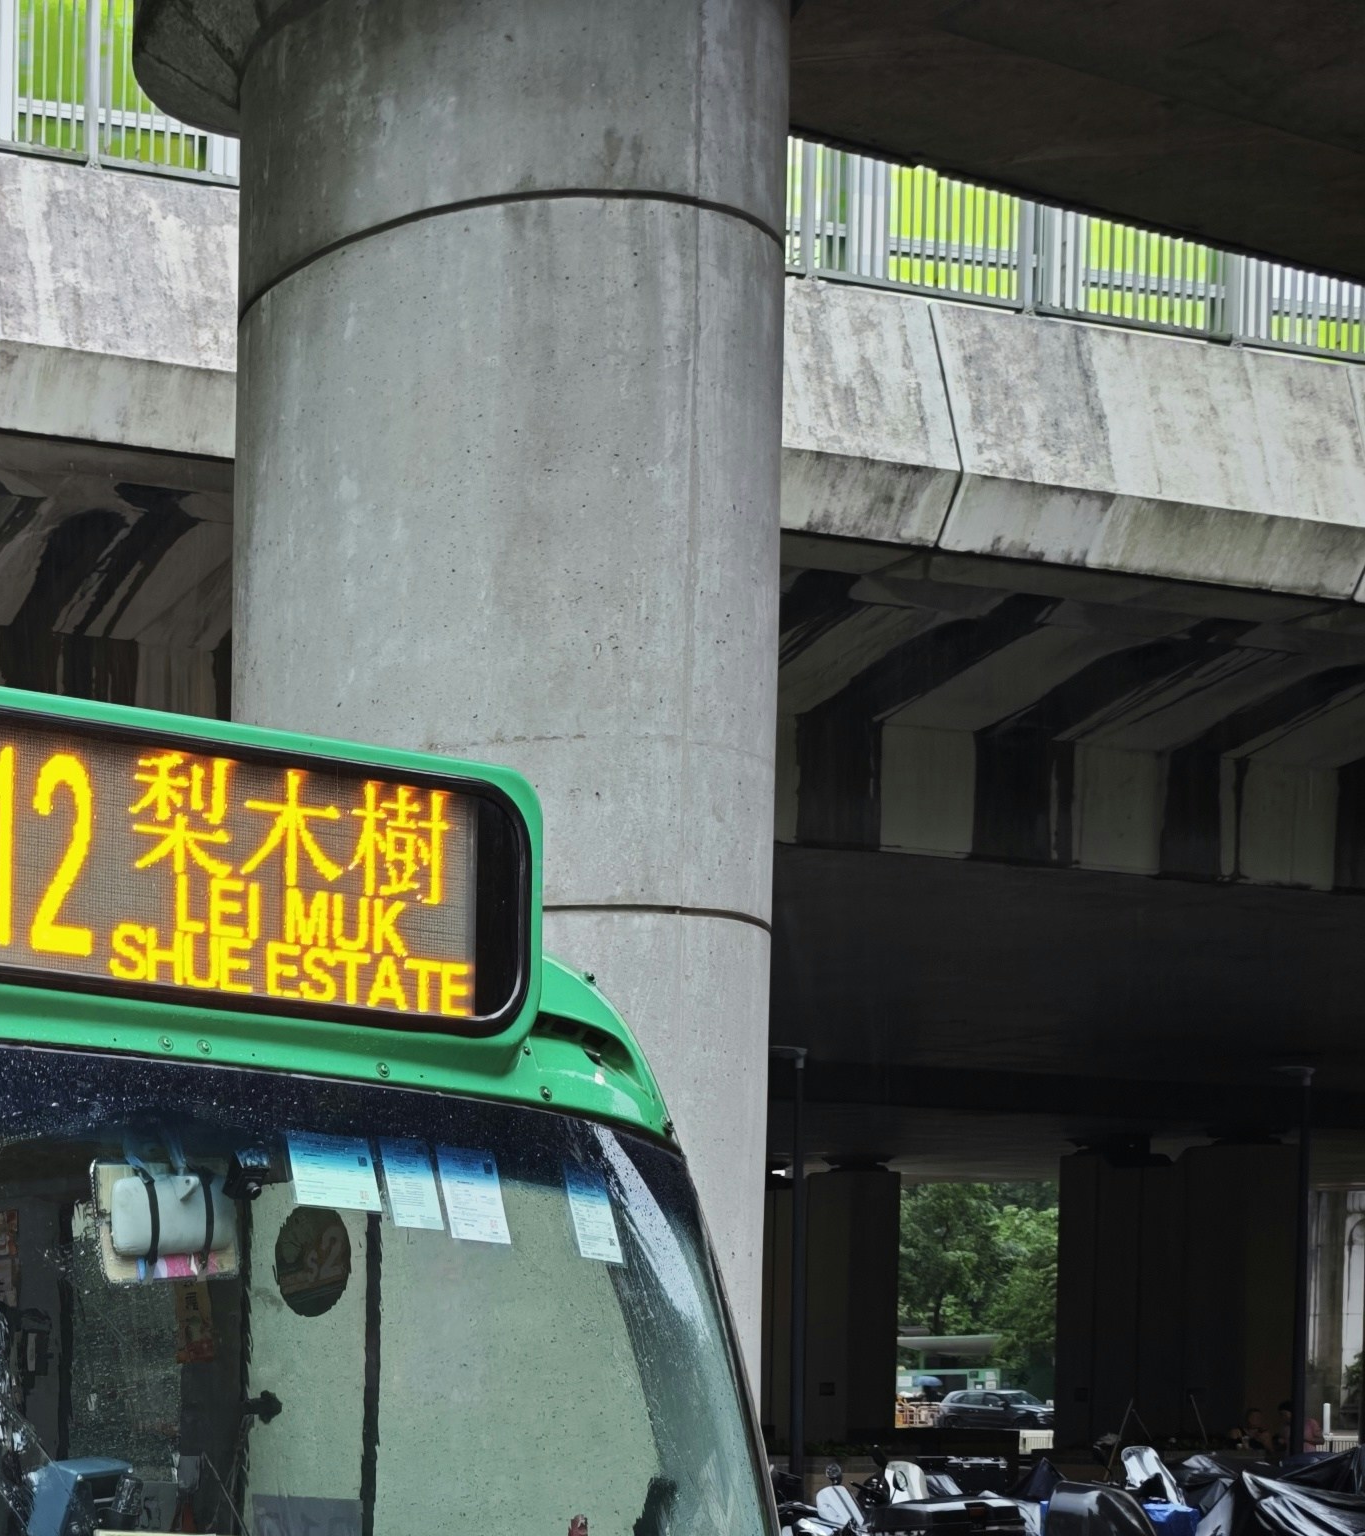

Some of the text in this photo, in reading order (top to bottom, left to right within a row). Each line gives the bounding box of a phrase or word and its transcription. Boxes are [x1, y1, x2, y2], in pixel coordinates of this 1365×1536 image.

[129, 750, 449, 904] 梨木樹
[176, 873, 408, 957] LEI MUK
[110, 923, 471, 1017] SHUE ESTATE
